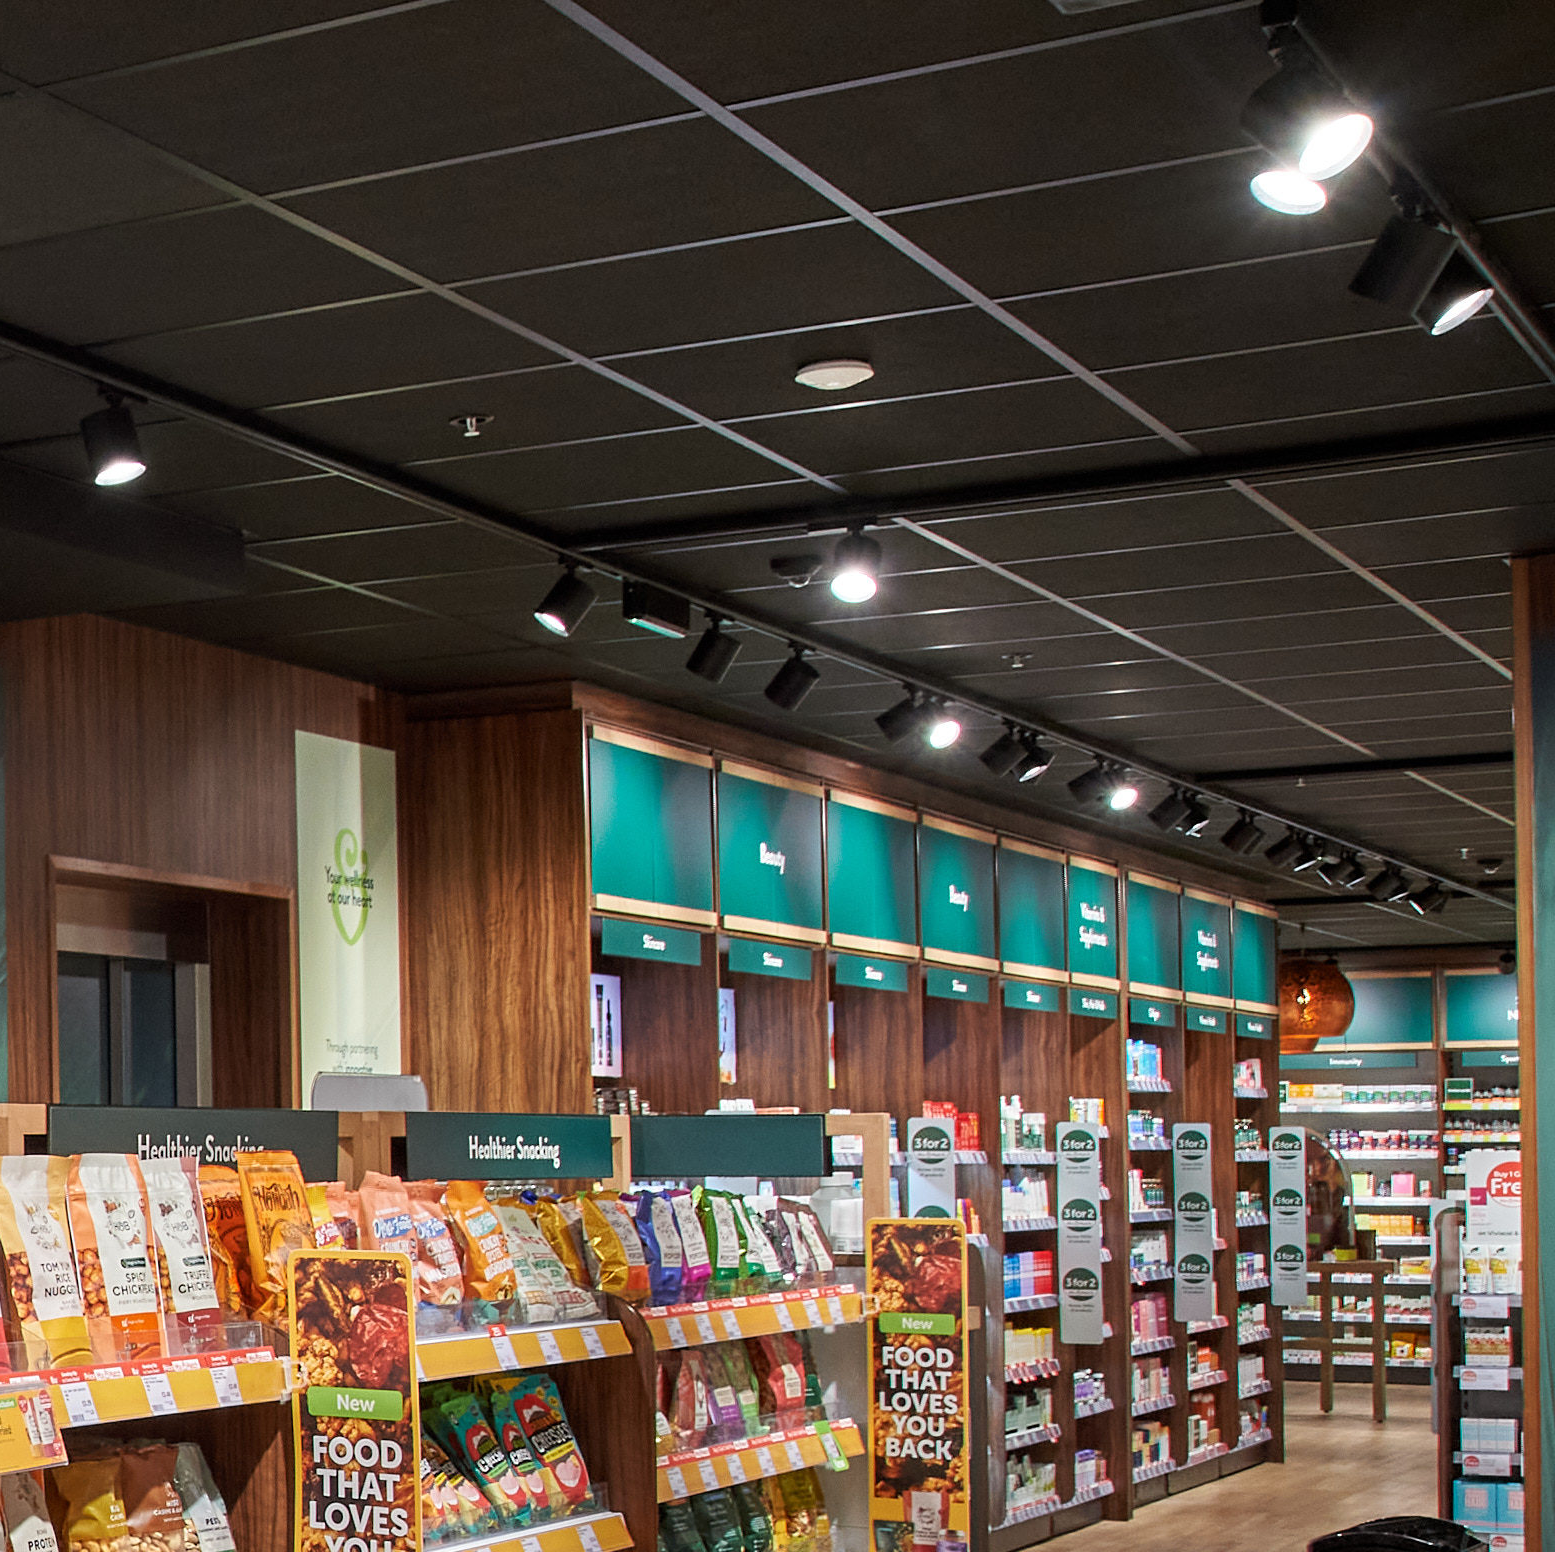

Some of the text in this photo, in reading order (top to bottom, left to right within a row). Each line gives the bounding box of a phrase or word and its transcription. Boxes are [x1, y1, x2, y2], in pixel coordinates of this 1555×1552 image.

[469, 1136, 560, 1168] Healthier Snacking
[882, 1346, 954, 1368] FOOD
[885, 1369, 952, 1391] THAT
[336, 1393, 375, 1413] New
[879, 1391, 958, 1415] LOVES
[893, 1416, 944, 1437] YOU
[312, 1435, 402, 1470] FOOD
[885, 1438, 952, 1460] BACK
[316, 1468, 400, 1502] THAT
[309, 1501, 408, 1537] LOVES
